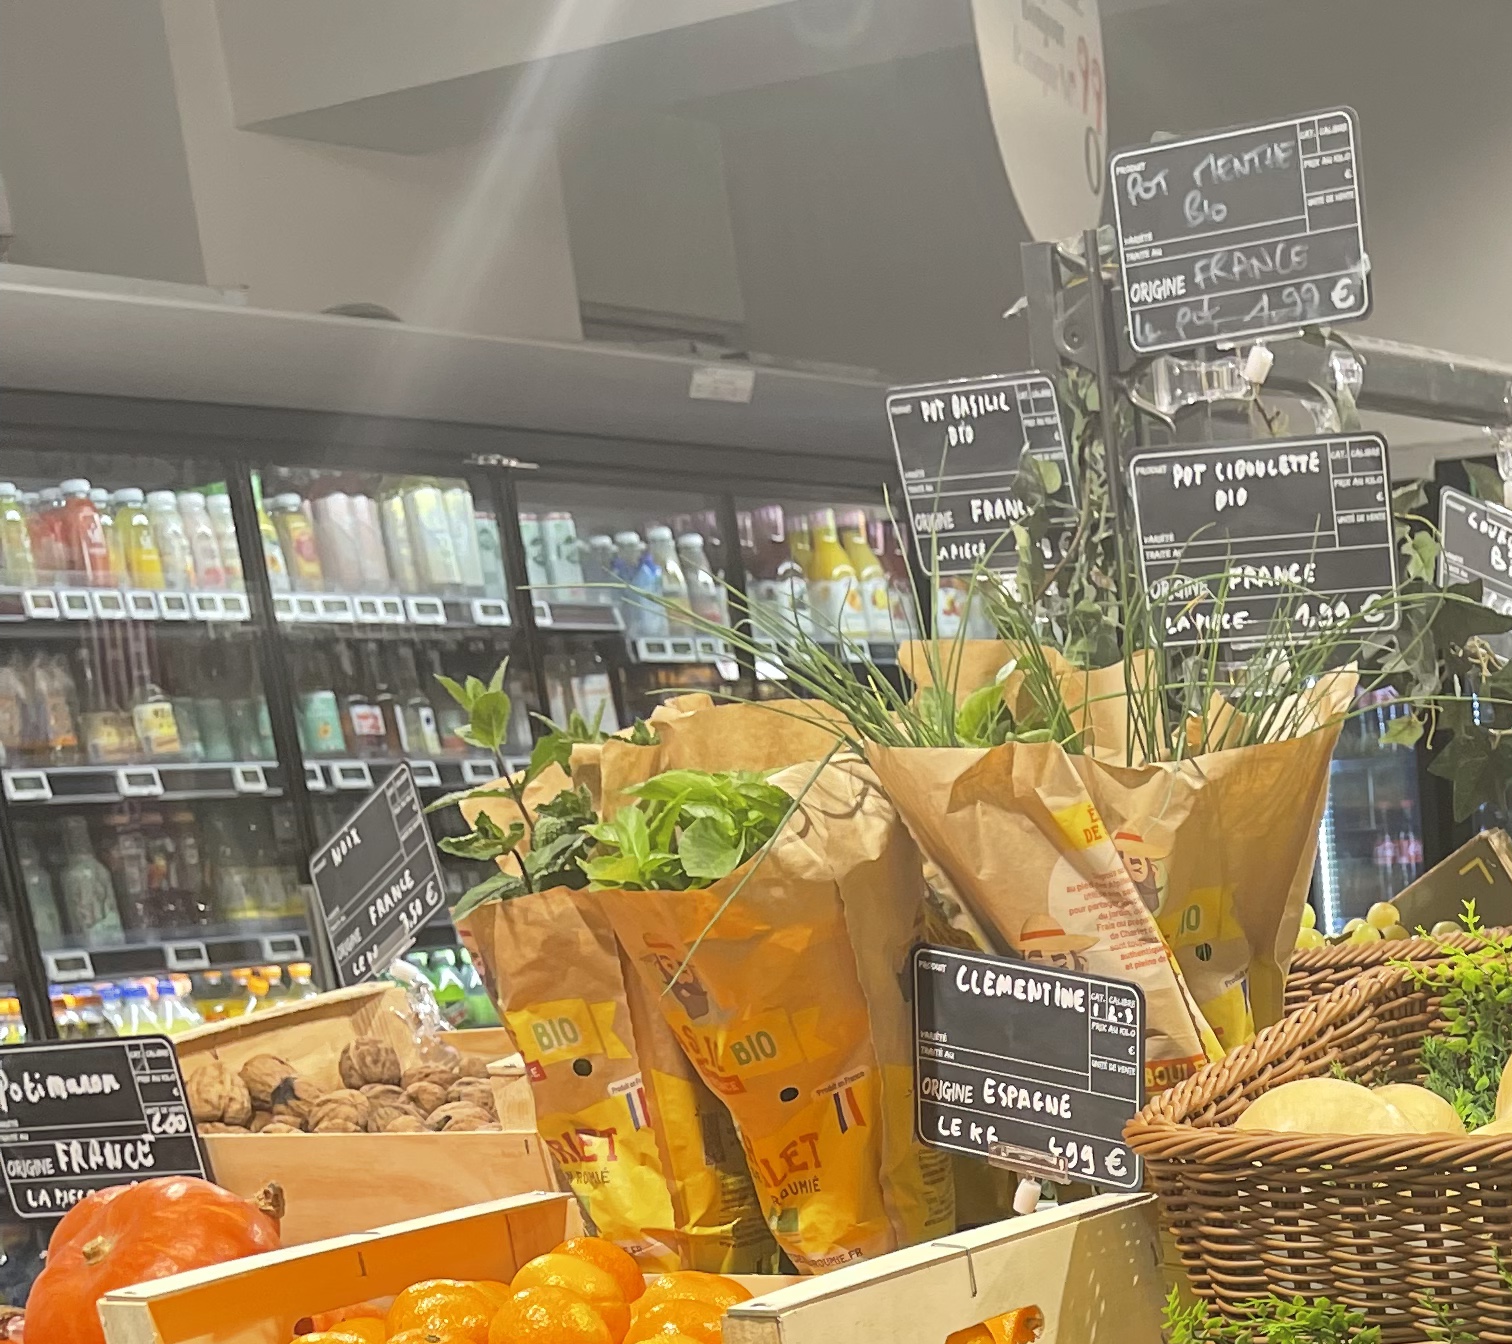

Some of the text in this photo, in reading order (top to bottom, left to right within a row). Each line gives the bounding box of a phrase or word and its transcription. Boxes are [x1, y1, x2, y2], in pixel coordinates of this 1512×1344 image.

[1127, 169, 1169, 206] POT
[1193, 242, 1309, 289] FRANCE
[1130, 275, 1186, 302] ORIGINE
[1331, 277, 1355, 310] €
[920, 399, 945, 422] POT
[1172, 451, 1320, 489] POT CIBOULETTE
[1229, 562, 1316, 590] FRANCE
[331, 827, 362, 867] NOIX
[1082, 825, 1103, 844] DE
[368, 869, 415, 926] FRANCE
[425, 881, 438, 906] €
[1108, 995, 1136, 1008] CALIBRE
[532, 1017, 579, 1052] BIO
[729, 1030, 777, 1066] BIO
[922, 1077, 974, 1104] ORIGINE
[983, 1077, 1072, 1119] ESPAGNE
[55, 1134, 156, 1173] FRANCE
[938, 1116, 962, 1137] LE
[1104, 1148, 1128, 1177] €
[7, 1157, 55, 1178] ORIGINE
[26, 1188, 52, 1208] LA
